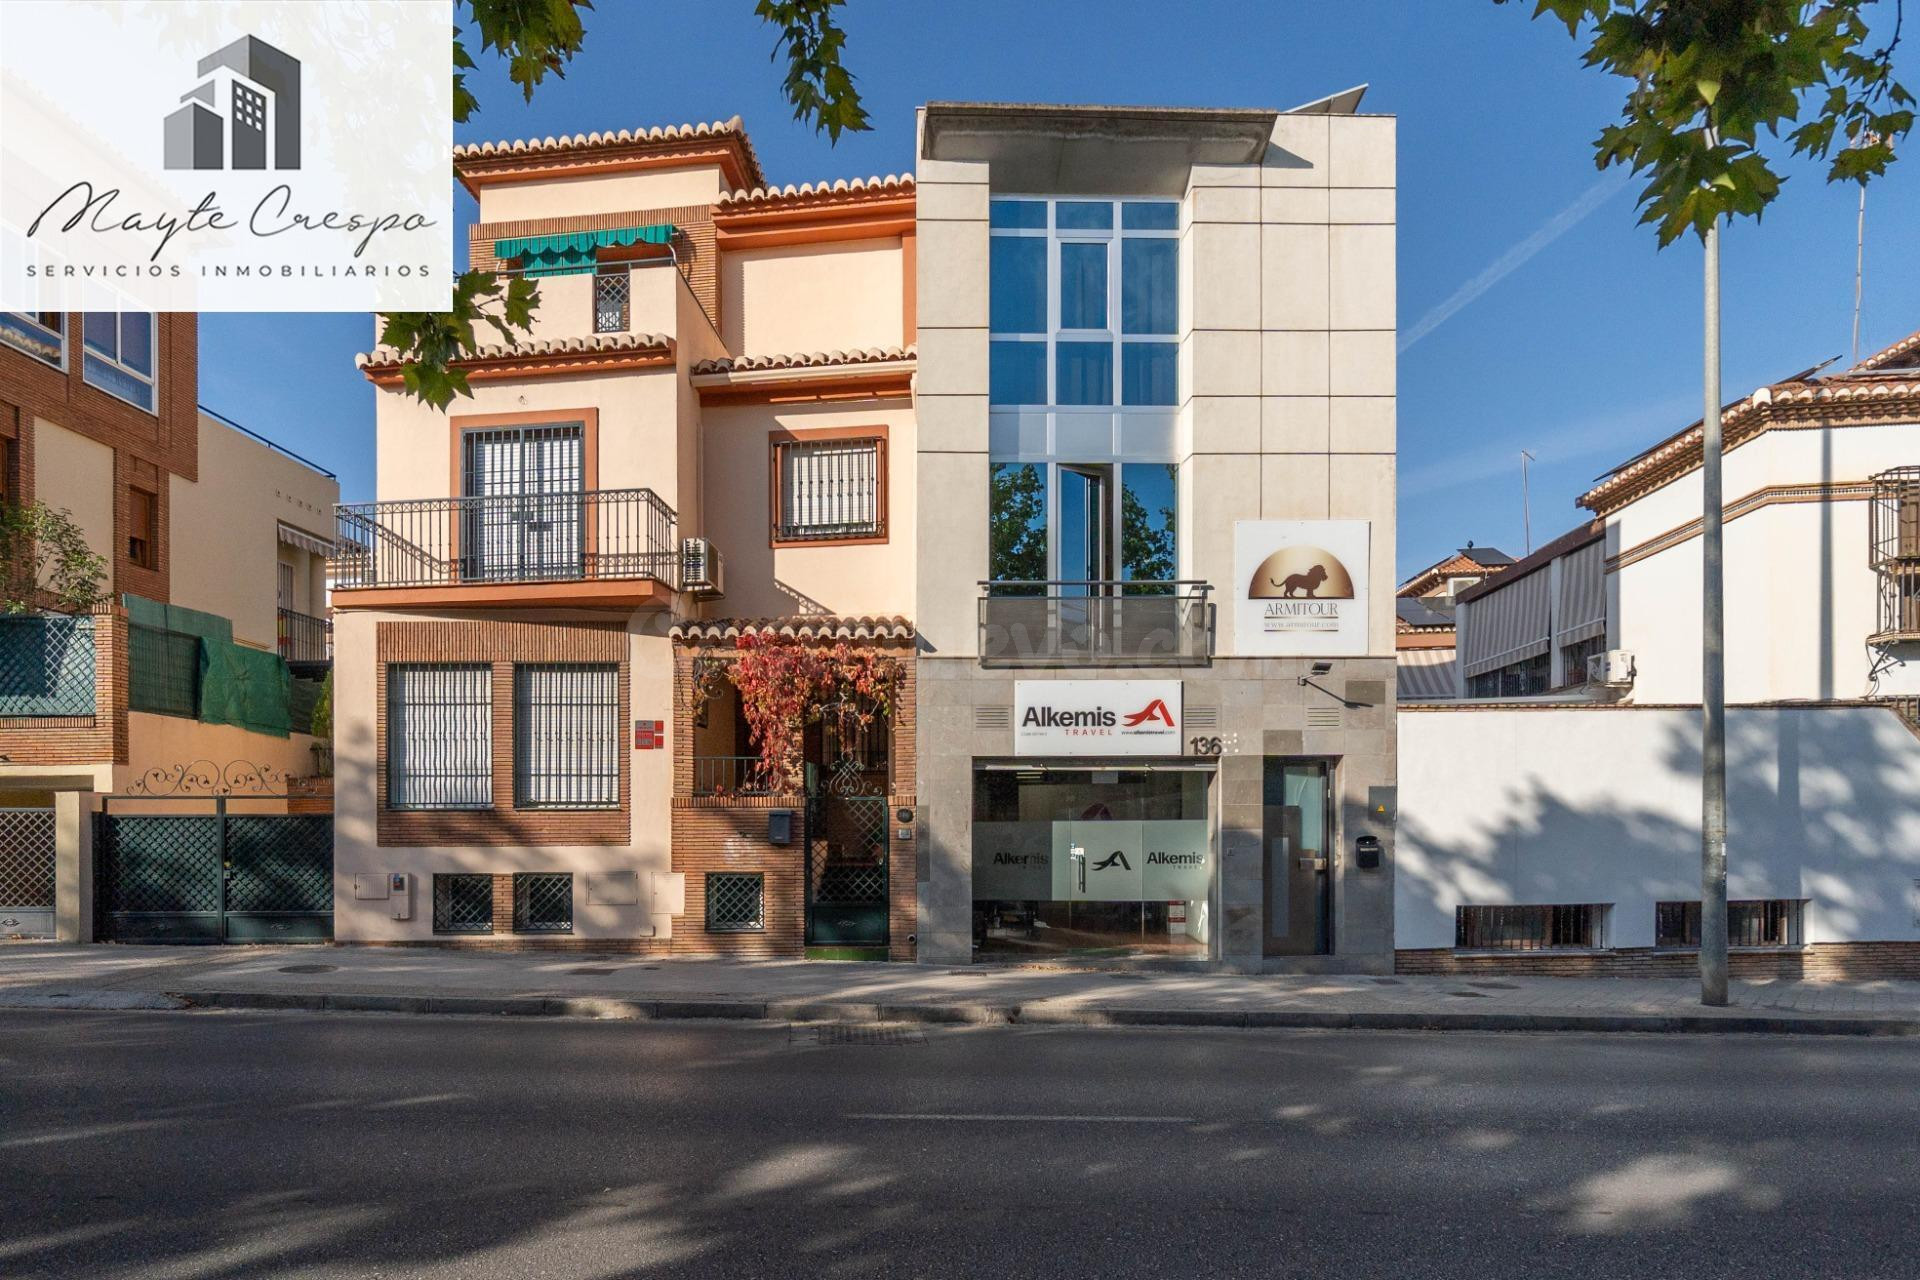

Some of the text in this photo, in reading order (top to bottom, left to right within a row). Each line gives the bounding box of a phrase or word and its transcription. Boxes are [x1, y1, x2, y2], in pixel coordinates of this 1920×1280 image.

[1264, 602, 1339, 616] ARMITOUR
[1022, 706, 1116, 727] Alkemis
[1190, 736, 1223, 755] 136
[1147, 851, 1205, 865] Alkemis
